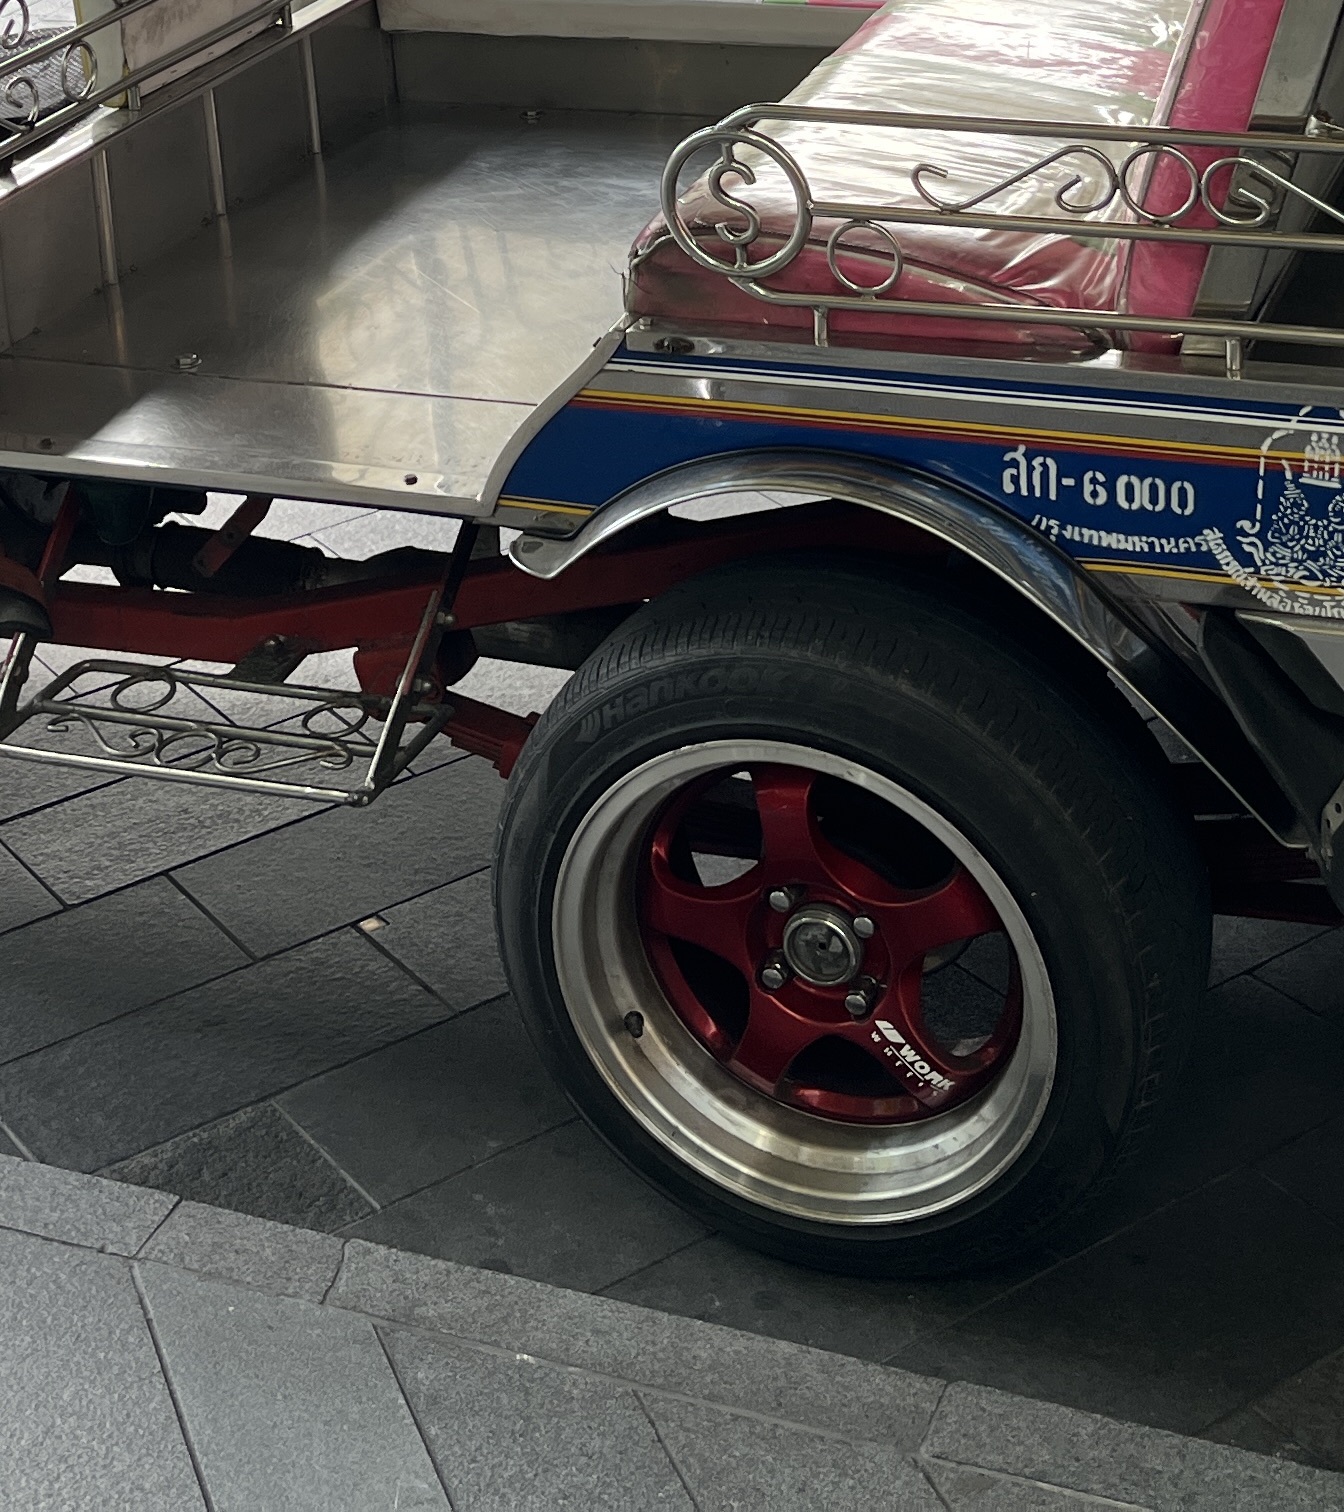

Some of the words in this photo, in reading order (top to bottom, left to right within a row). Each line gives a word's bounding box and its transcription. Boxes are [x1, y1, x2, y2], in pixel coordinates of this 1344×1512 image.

[1031, 513, 1212, 554] กรุงเทพมหานคร
[604, 664, 792, 731] Hankook
[899, 1043, 956, 1091] WORK
